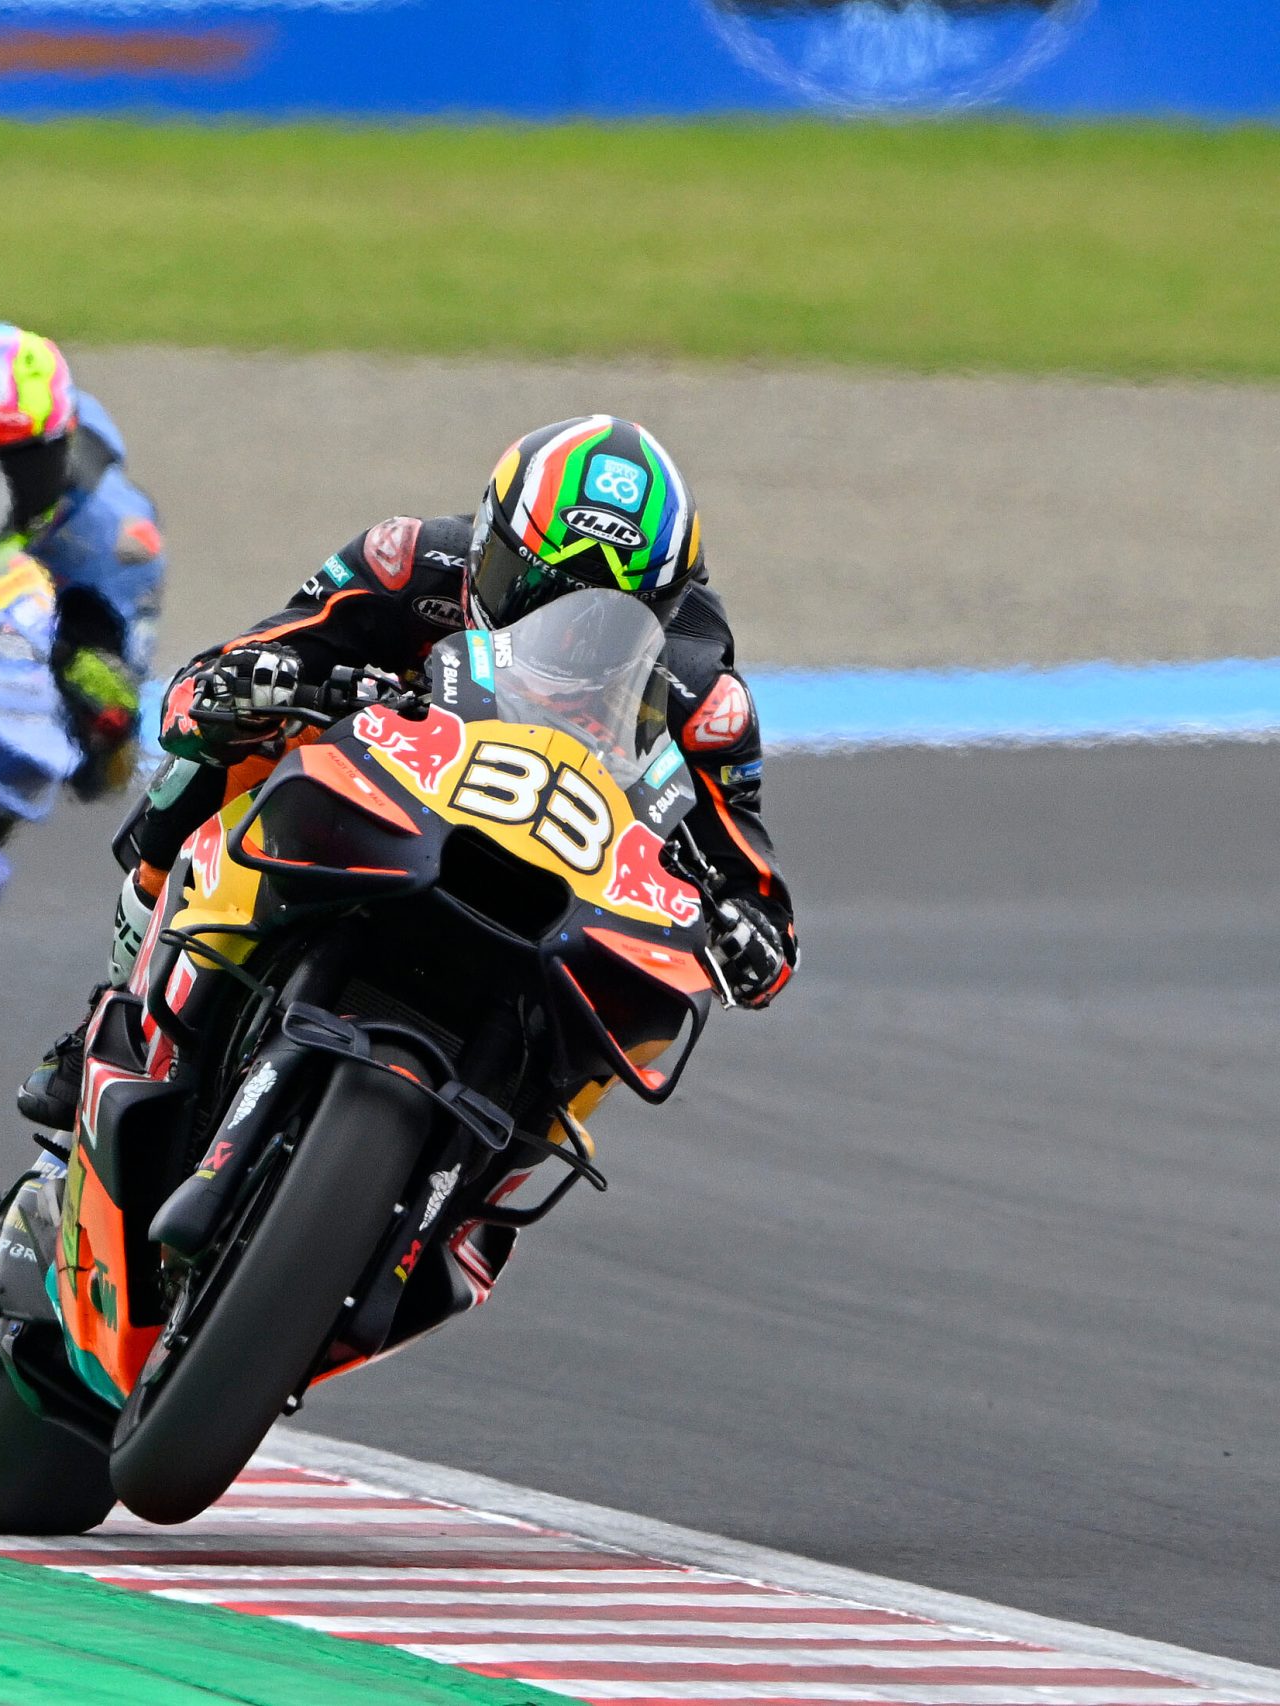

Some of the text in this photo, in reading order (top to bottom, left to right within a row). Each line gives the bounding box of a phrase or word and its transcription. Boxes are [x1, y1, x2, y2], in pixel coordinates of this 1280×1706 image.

[569, 512, 638, 544] HJC
[519, 546, 557, 577] GIVES
[566, 577, 593, 591] YO
[494, 632, 513, 668] WRS
[443, 667, 458, 704] BAJAJ
[449, 741, 613, 875] 33
